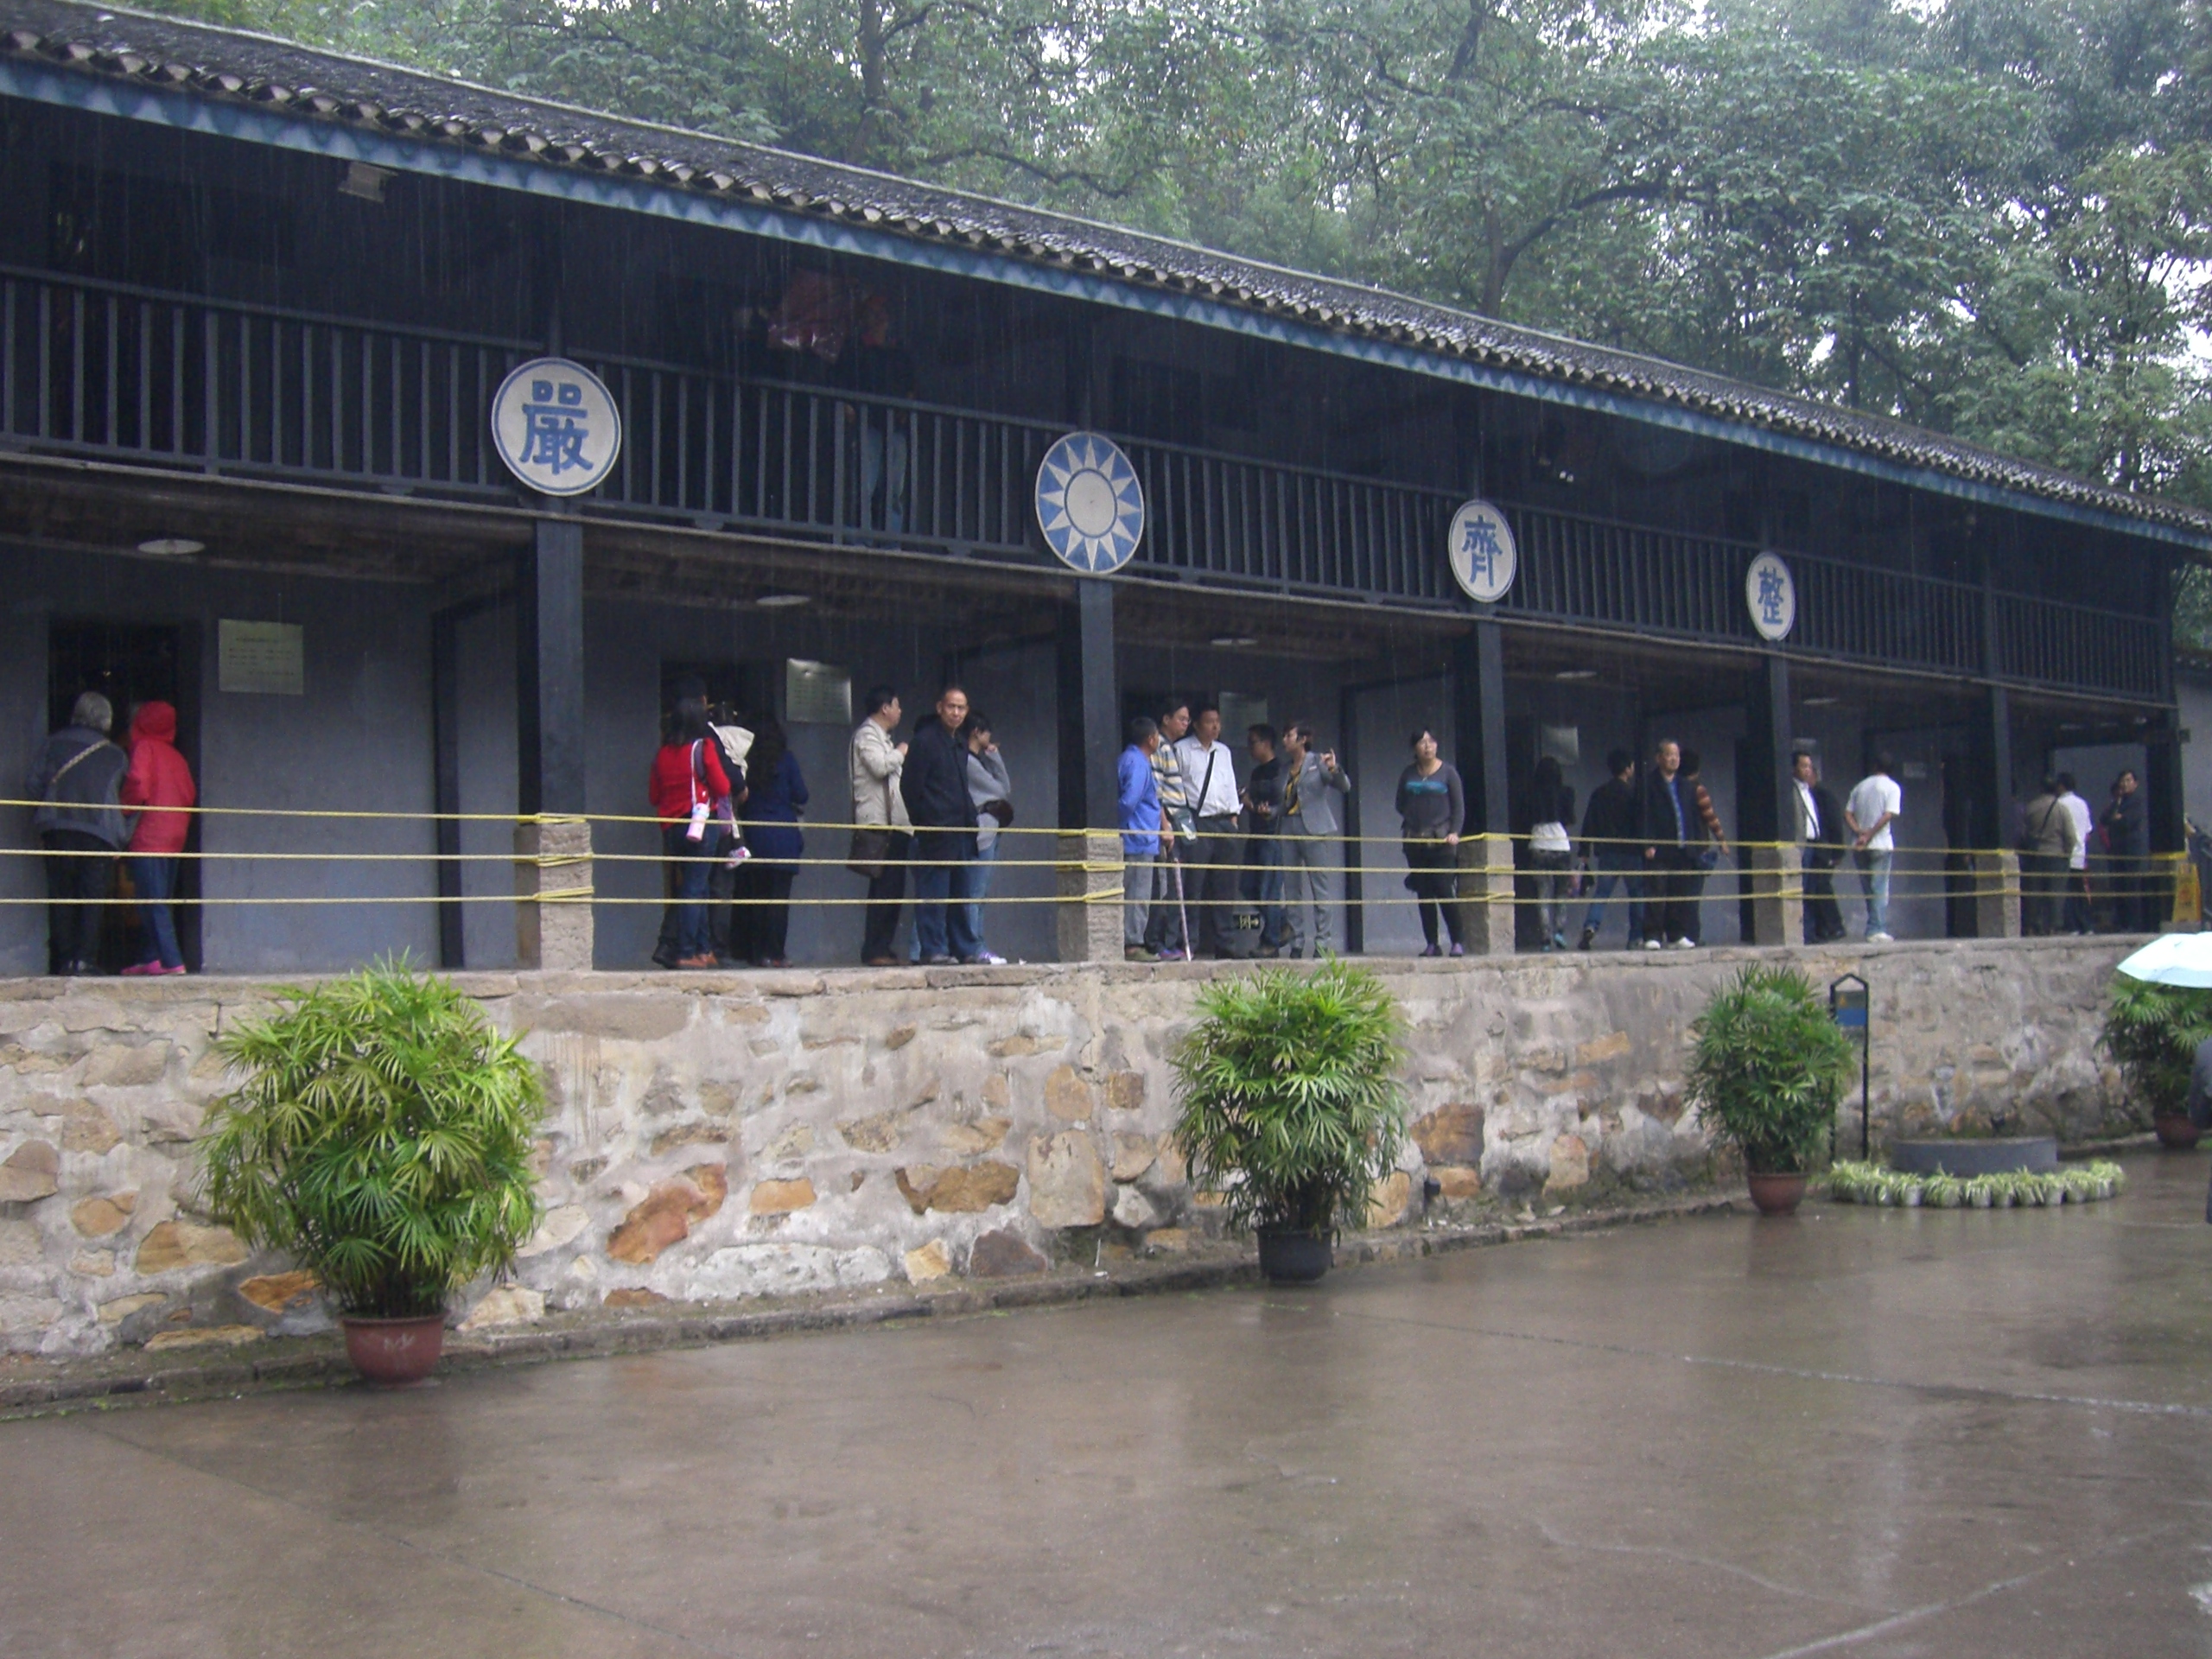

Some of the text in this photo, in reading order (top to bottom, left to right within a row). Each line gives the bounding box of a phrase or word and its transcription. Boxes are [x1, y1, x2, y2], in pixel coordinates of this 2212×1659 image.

[519, 379, 594, 475] 嚴
[1461, 514, 1503, 588] 齊
[1758, 566, 1783, 625] 整
